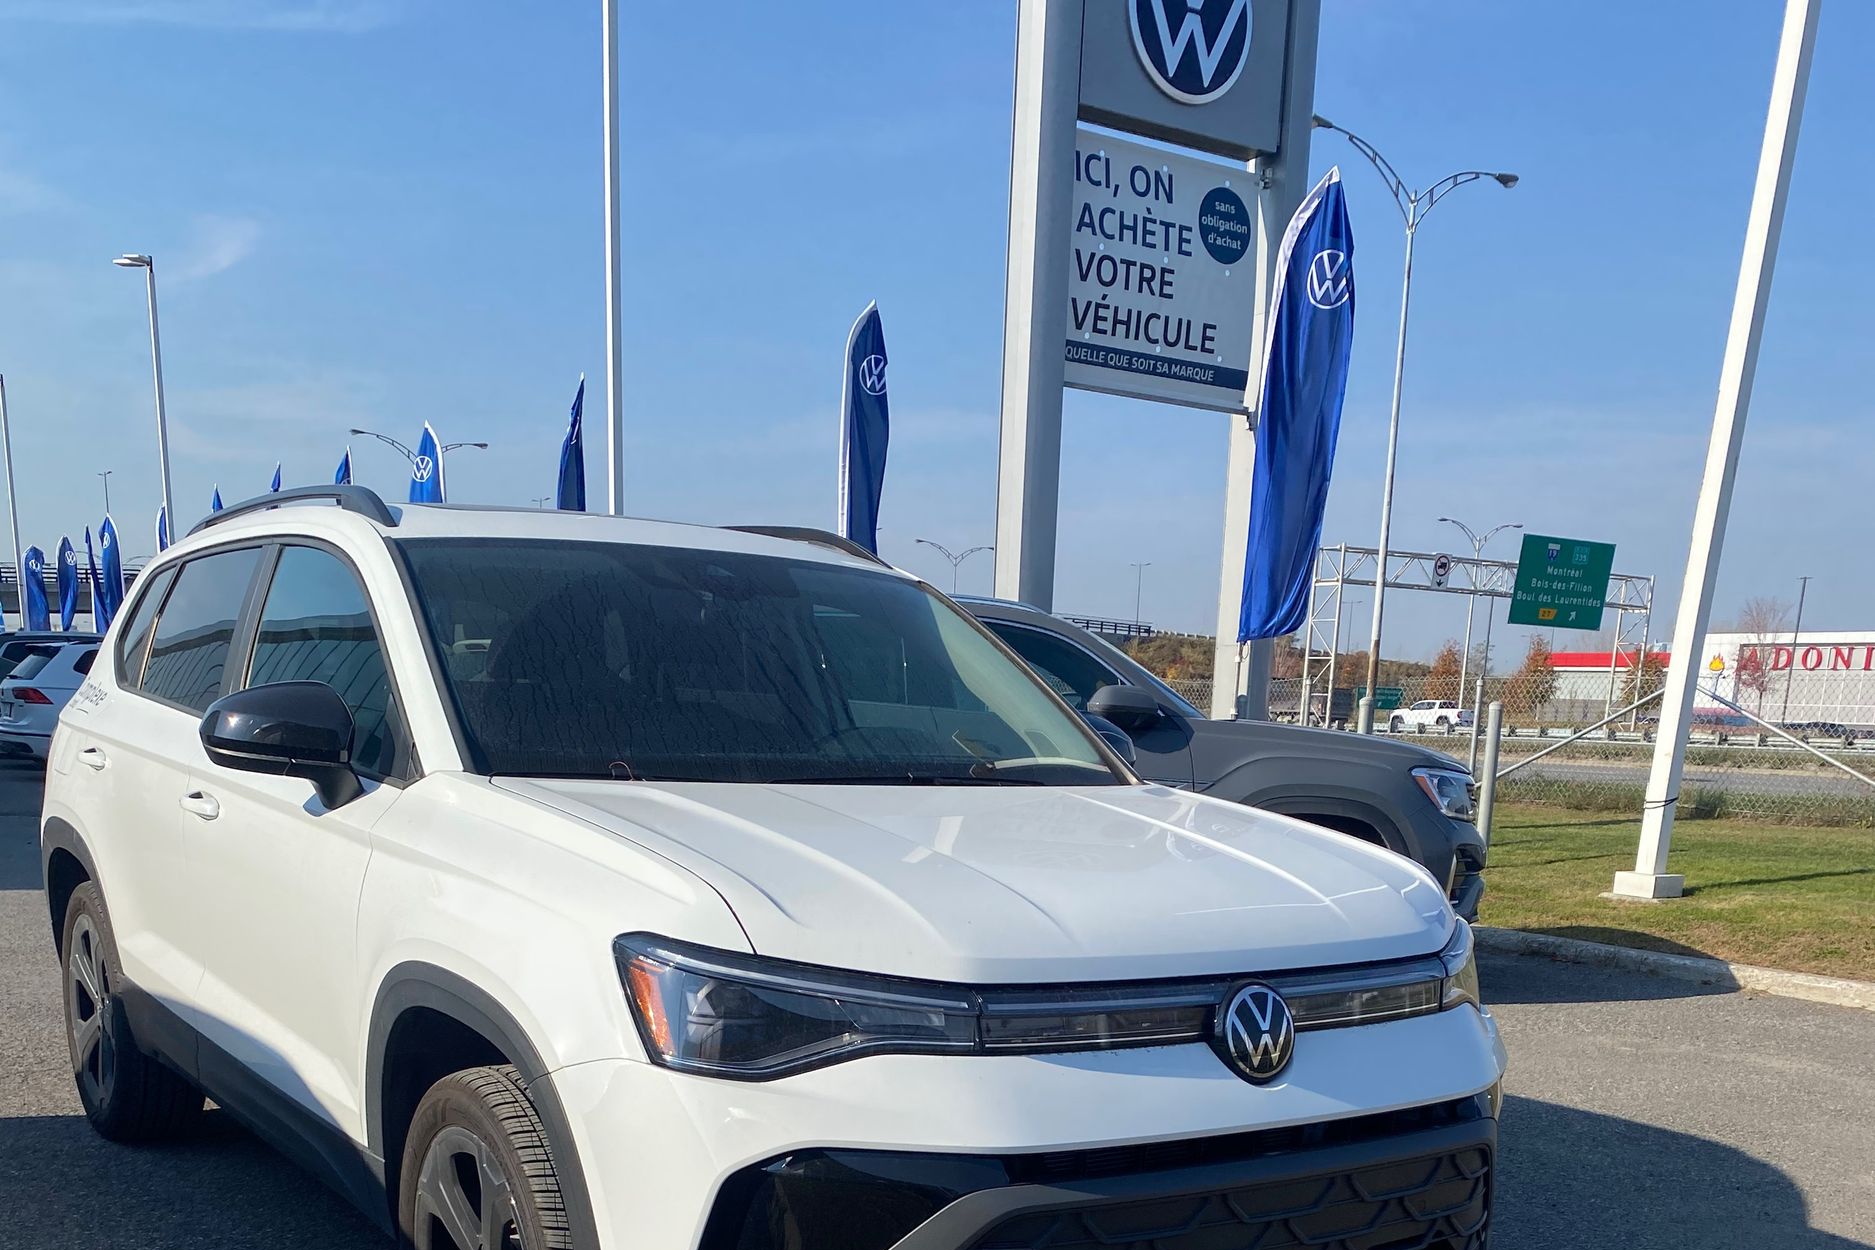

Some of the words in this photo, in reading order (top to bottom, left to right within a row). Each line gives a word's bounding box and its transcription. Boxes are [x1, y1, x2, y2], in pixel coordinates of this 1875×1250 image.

[1075, 150, 1119, 198] ICI,
[1129, 165, 1173, 204] ON
[1215, 201, 1235, 214] sans
[1076, 202, 1193, 257] ACHÈTE
[1201, 214, 1248, 234] obligation
[1208, 232, 1241, 250] d'achat
[1075, 248, 1175, 300] VOTRE
[1071, 294, 1217, 354] VÉHICULE
[1065, 345, 1105, 362] QUELLE
[1107, 353, 1130, 367] QUE
[1131, 357, 1155, 371] SOIT
[1156, 362, 1169, 374] SA
[1170, 364, 1214, 382] MARQUE
[1531, 578, 1593, 592] Bois-des-Filion
[1538, 592, 1552, 603] des
[1554, 594, 1601, 608] Laurentides
